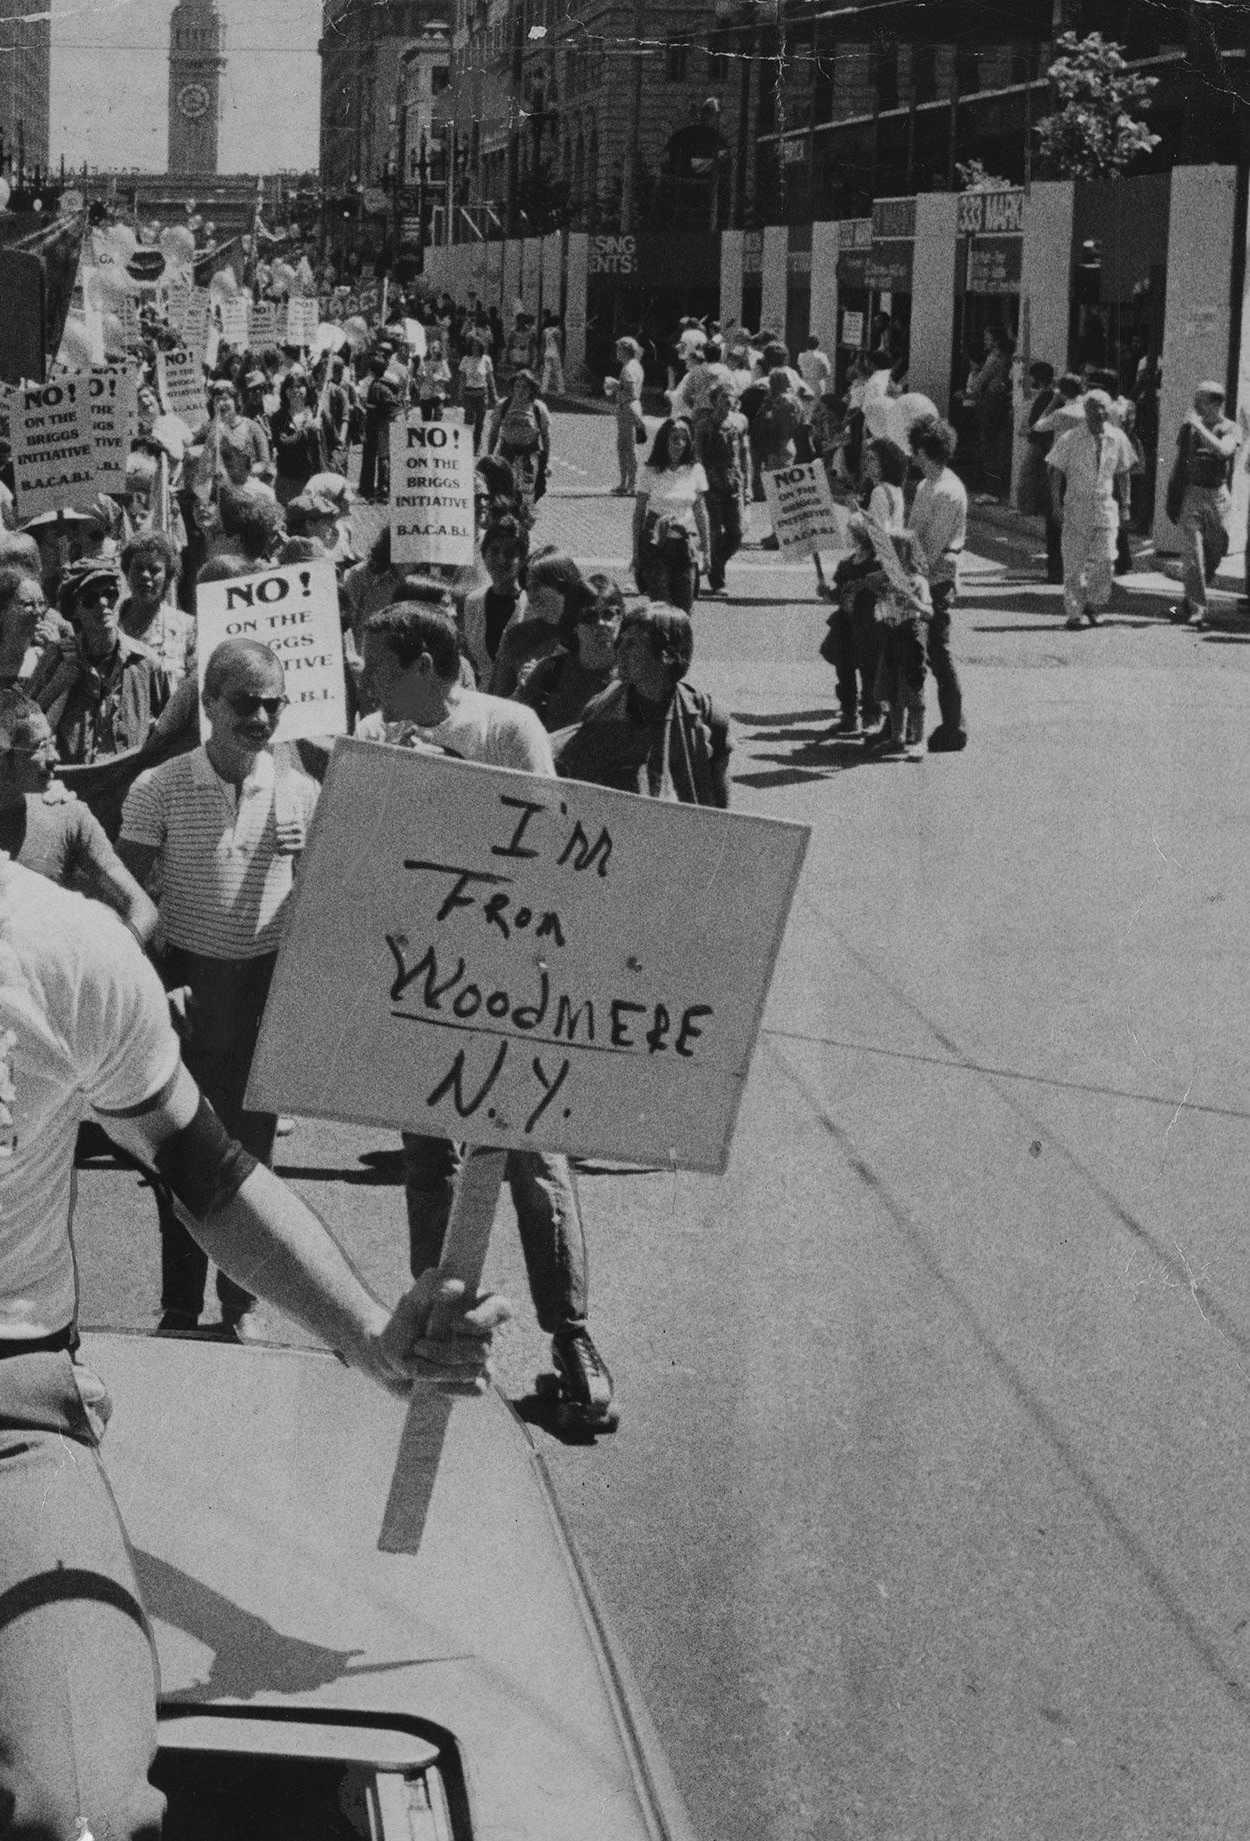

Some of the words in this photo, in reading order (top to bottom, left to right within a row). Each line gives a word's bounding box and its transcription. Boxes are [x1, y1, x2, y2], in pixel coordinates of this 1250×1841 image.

[24, 383, 77, 411] NO!
[25, 417, 45, 429] ON
[48, 411, 78, 425] THE
[26, 429, 79, 447] BRIGGS
[406, 427, 460, 449] NO!
[17, 444, 91, 466] INITIATIVE
[406, 458, 428, 469] ON
[433, 458, 459, 470] THE
[406, 477, 460, 489] BRIGGS
[395, 495, 471, 509] INITIATIVE
[225, 571, 312, 610] NO!
[225, 619, 258, 635] ON
[266, 611, 314, 628] THE
[427, 1040, 571, 1133] N.Y.
